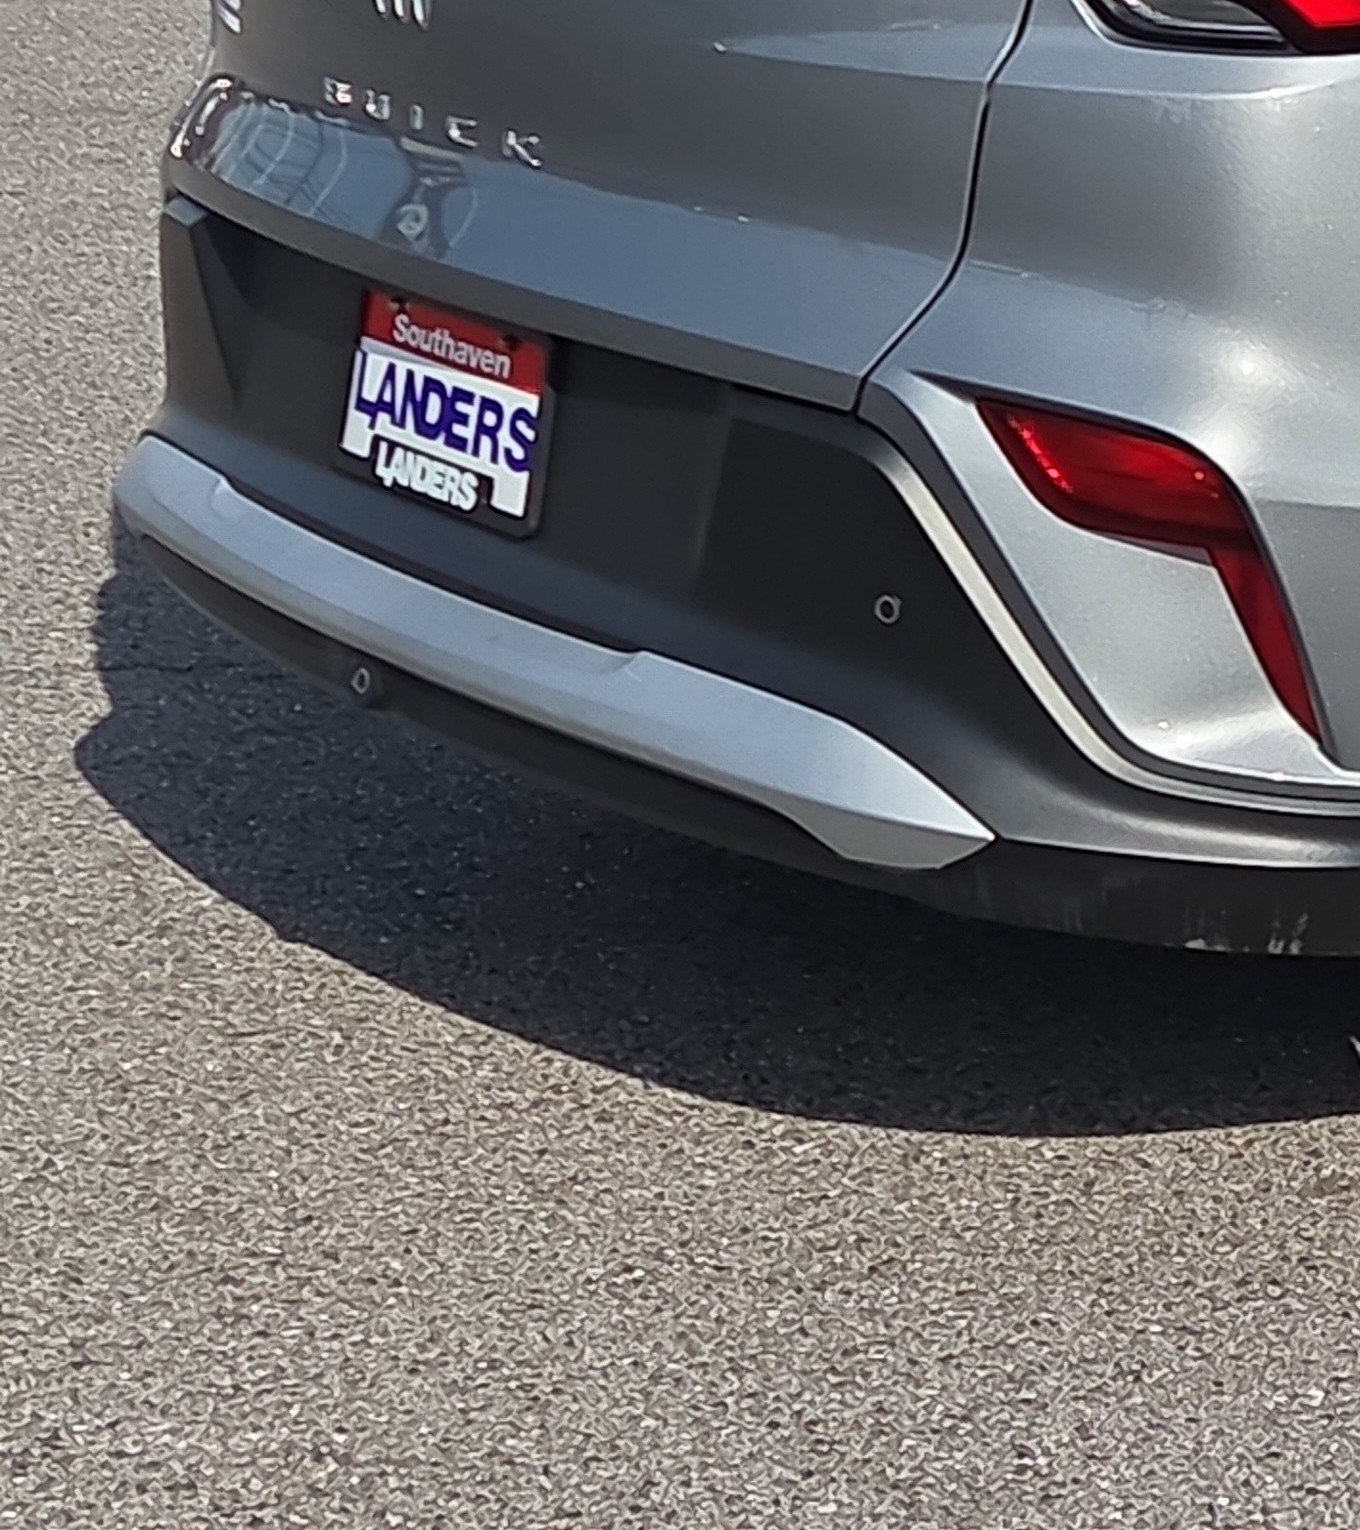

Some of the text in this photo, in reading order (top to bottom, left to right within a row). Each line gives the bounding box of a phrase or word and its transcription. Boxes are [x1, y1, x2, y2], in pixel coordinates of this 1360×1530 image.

[323, 76, 543, 168] BUICK
[392, 313, 512, 380] Southaven
[354, 347, 540, 473] LANDERS
[374, 440, 480, 512] LANDERS
